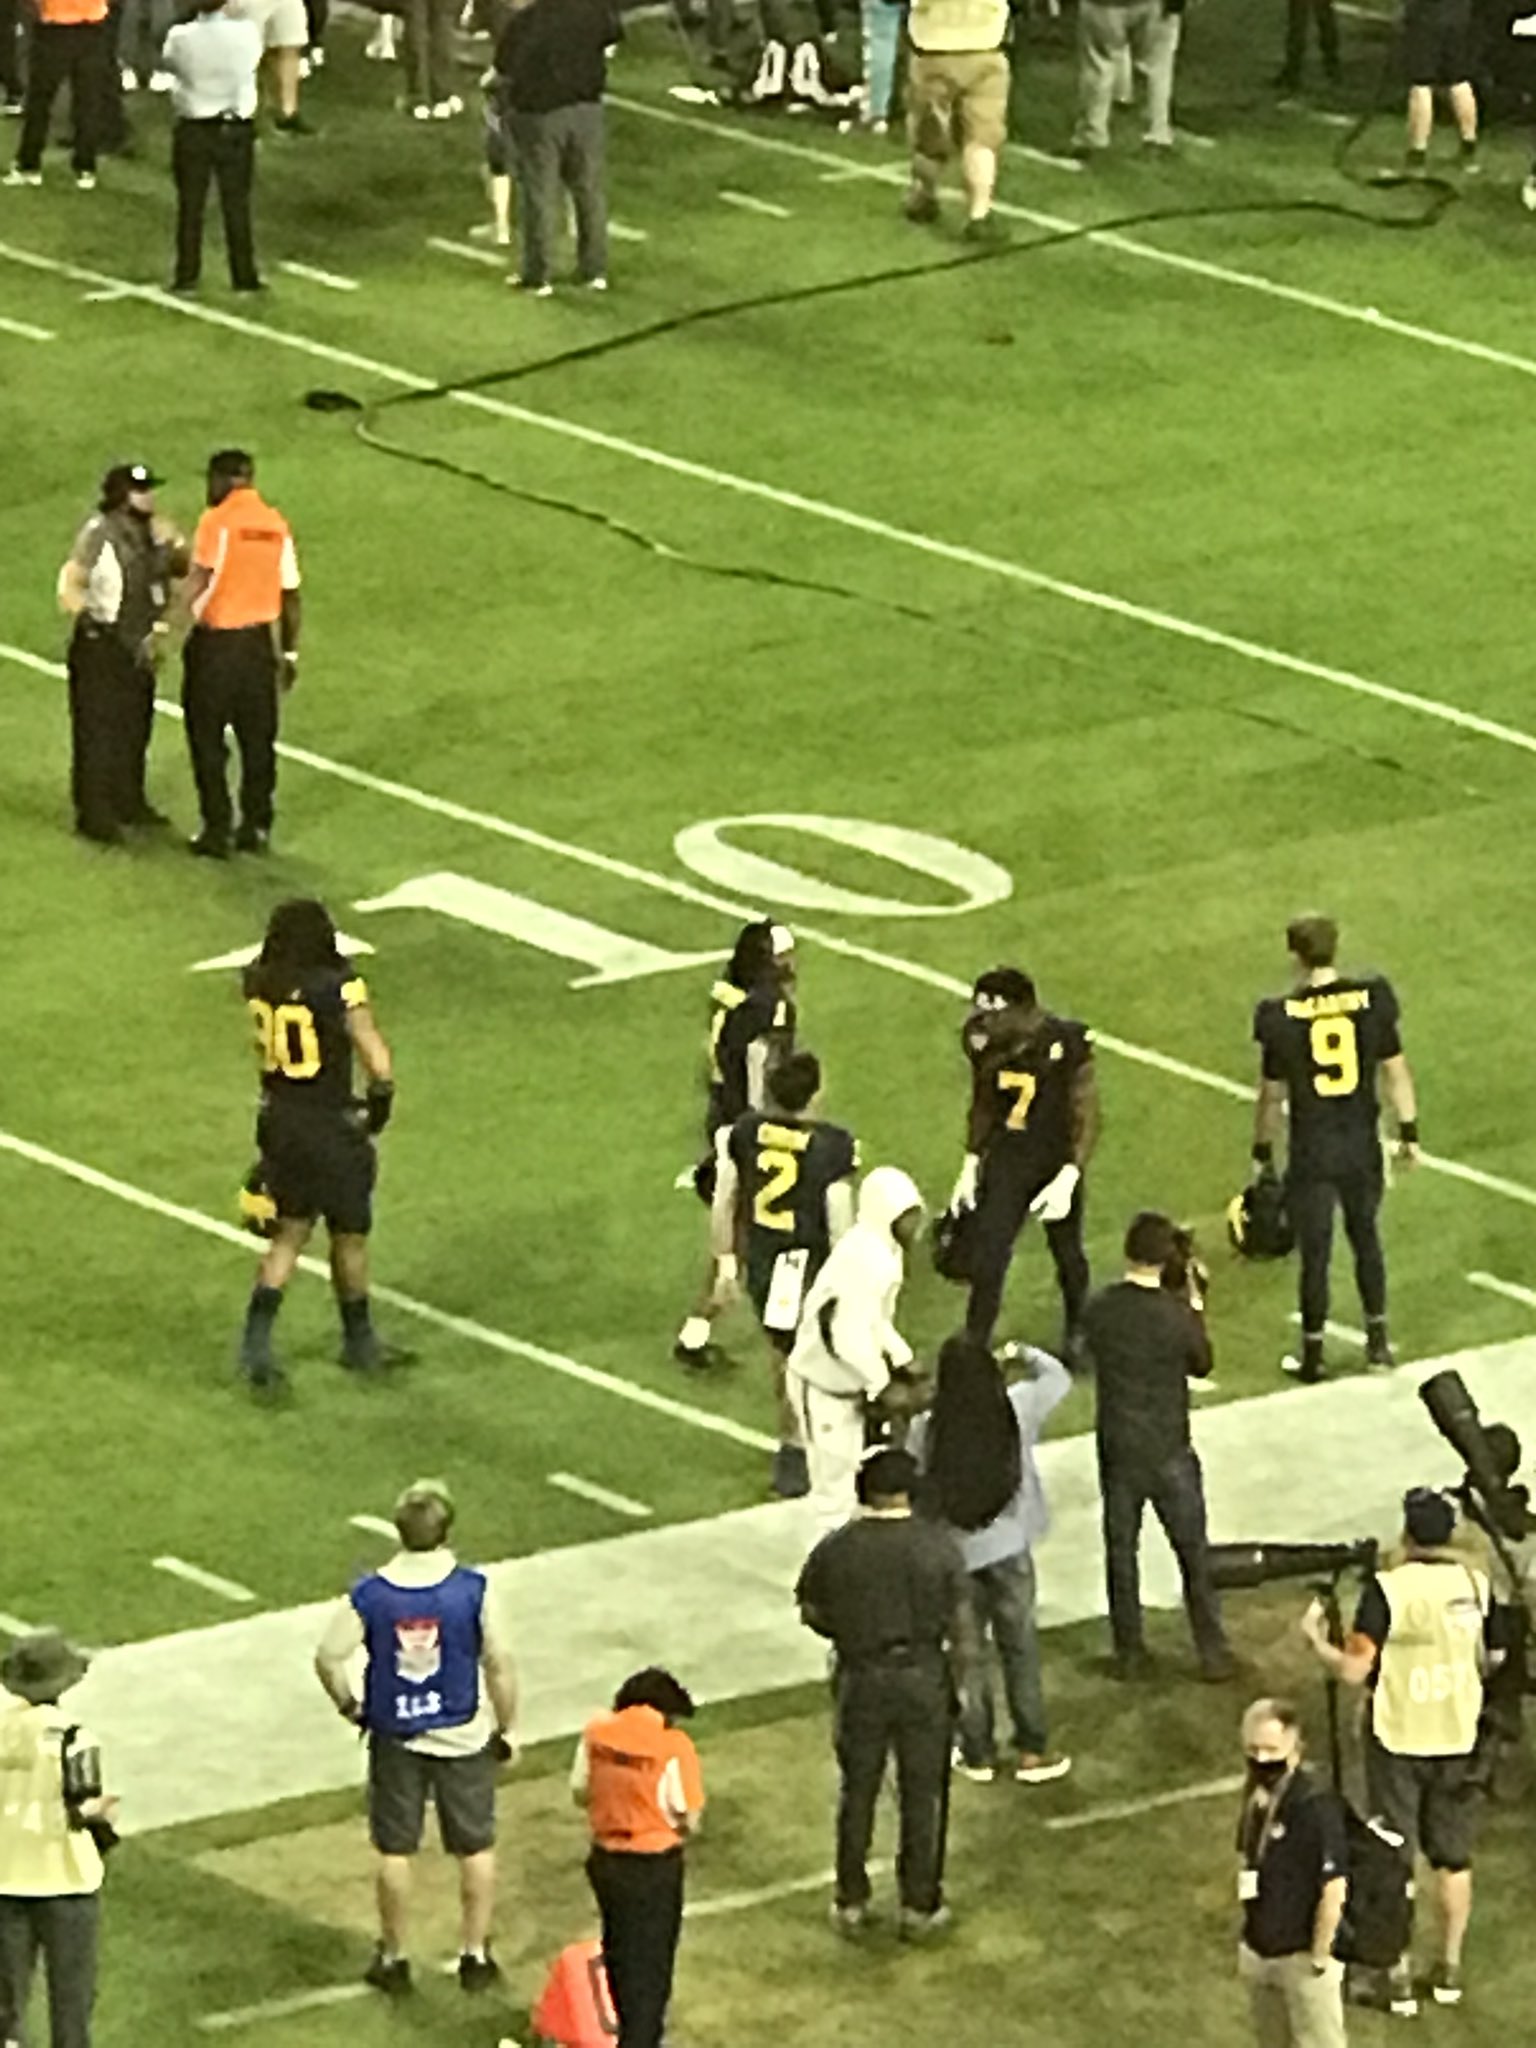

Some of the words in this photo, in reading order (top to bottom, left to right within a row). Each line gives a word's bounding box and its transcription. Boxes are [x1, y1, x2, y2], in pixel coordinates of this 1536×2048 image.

[1310, 1016, 1359, 1097] 9
[998, 1070, 1036, 1130] 7
[755, 1149, 798, 1231] 2
